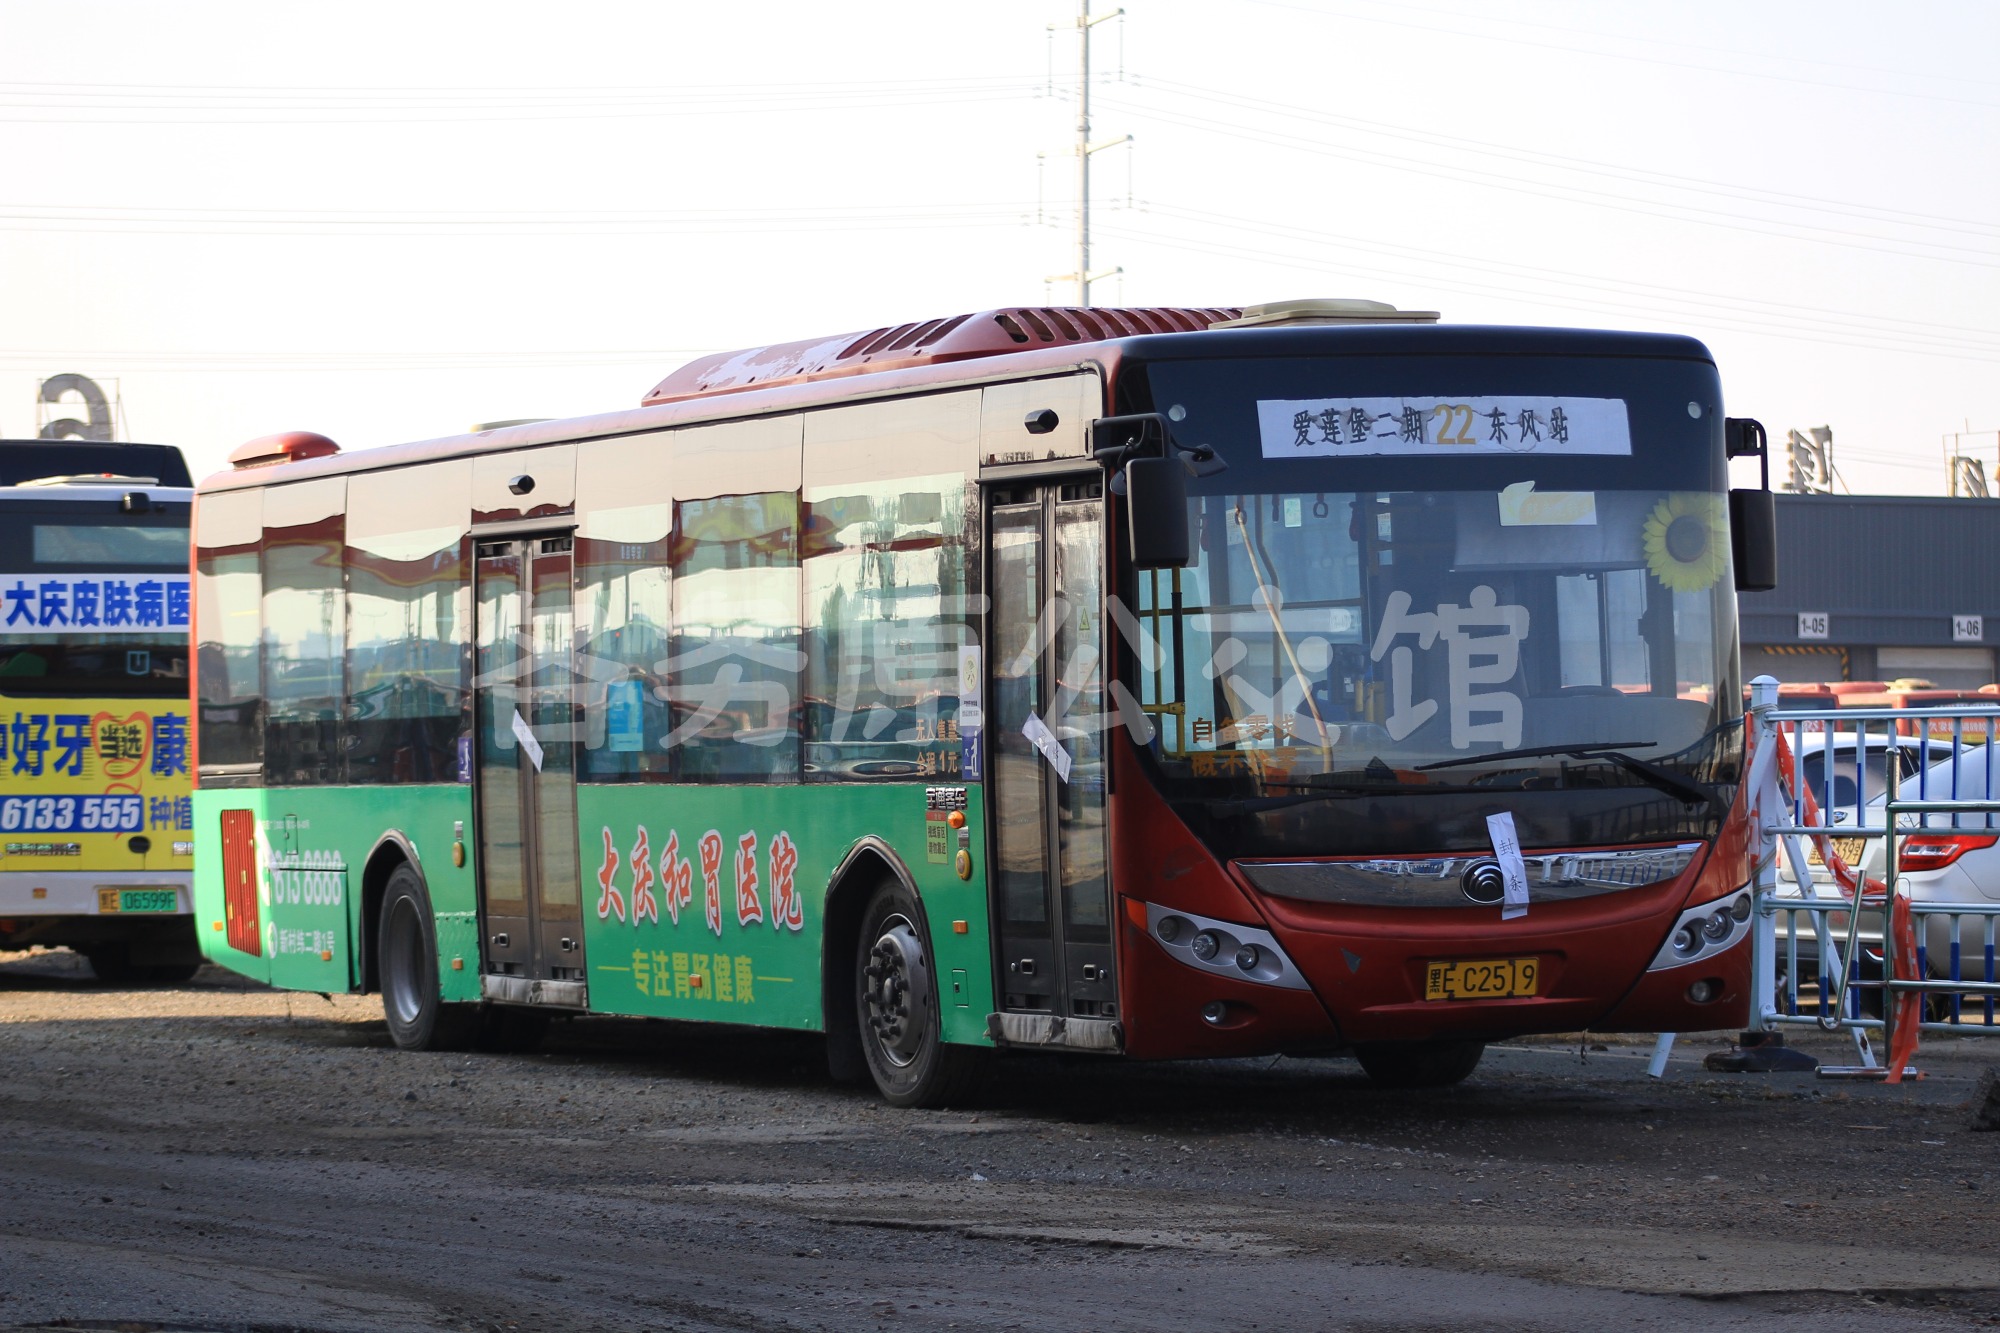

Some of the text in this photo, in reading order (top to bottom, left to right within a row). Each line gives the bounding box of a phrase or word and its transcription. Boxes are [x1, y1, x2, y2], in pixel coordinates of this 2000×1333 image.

[1293, 403, 1569, 447] 爱莲堡二期 22 东风站
[5, 579, 190, 628] 大庆皮肤病医
[1800, 617, 1826, 635] 1-05
[1955, 619, 1980, 637] 1-06
[0, 712, 92, 777] 好牙
[915, 718, 958, 742] 无人售票
[915, 750, 958, 776] 全程1元
[1, 797, 76, 830] 6133
[81, 797, 142, 830] 555
[598, 824, 804, 937] 大庆和胃医院
[1498, 837, 1524, 893] 封条
[632, 948, 756, 1005] 专注胃肠健康
